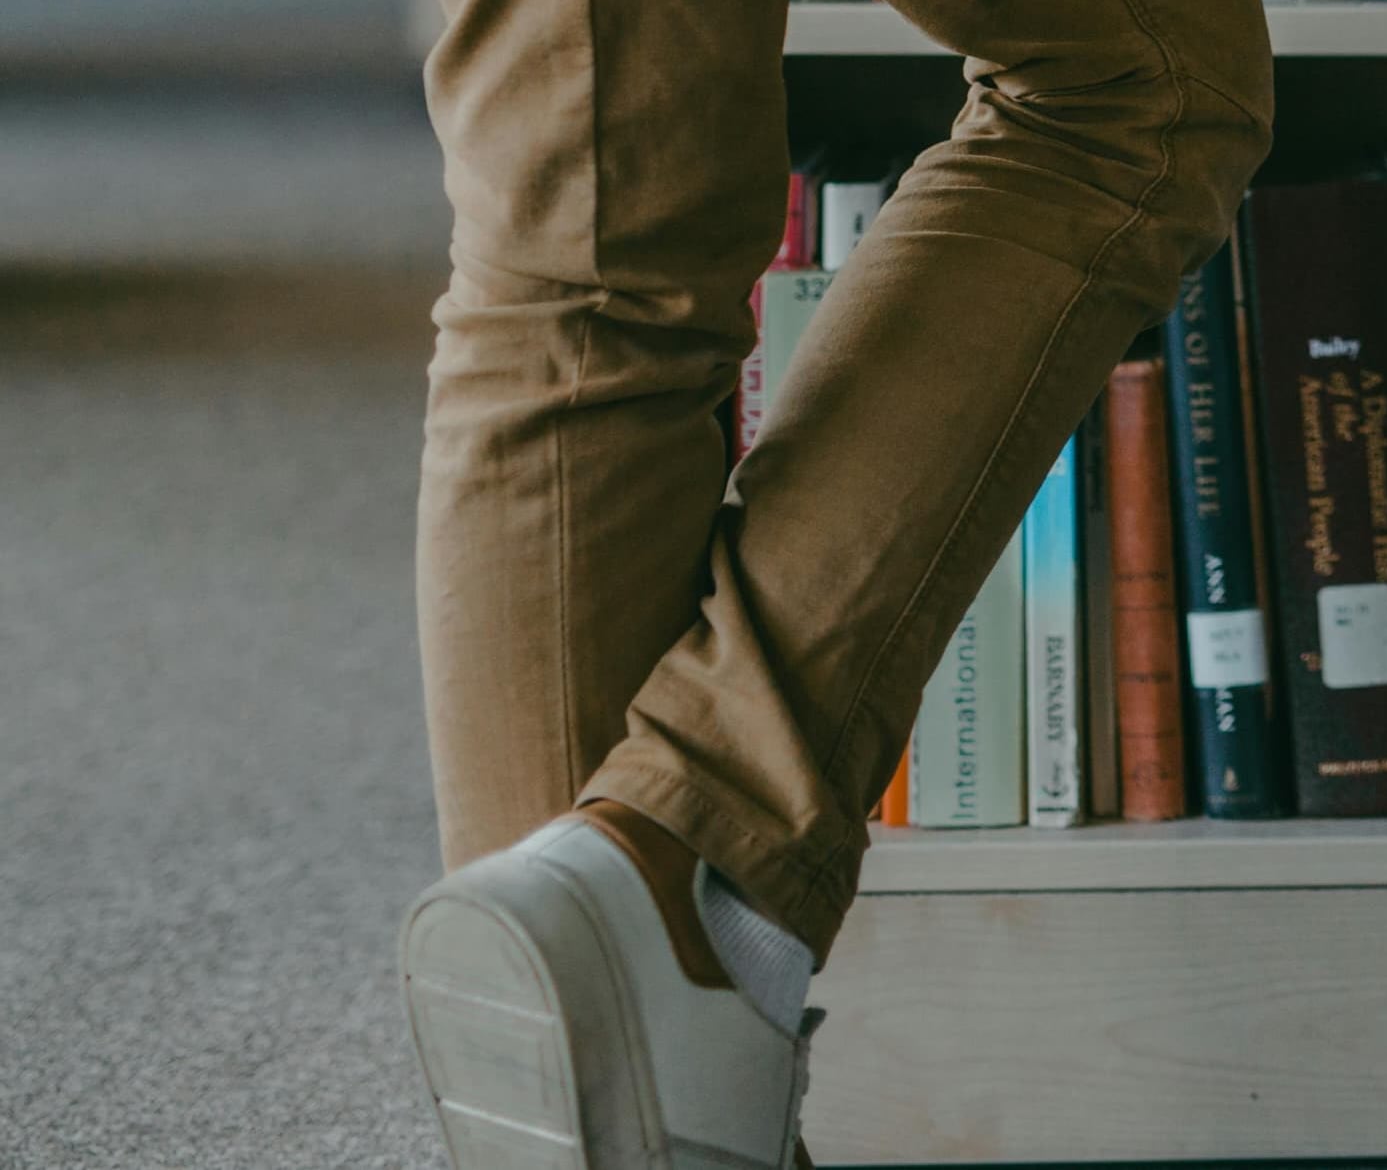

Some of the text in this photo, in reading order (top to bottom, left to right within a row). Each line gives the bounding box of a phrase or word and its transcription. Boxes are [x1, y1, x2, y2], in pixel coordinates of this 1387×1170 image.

[1360, 370, 1383, 391] A
[1300, 375, 1338, 577] American People
[1203, 553, 1228, 605] ANN
